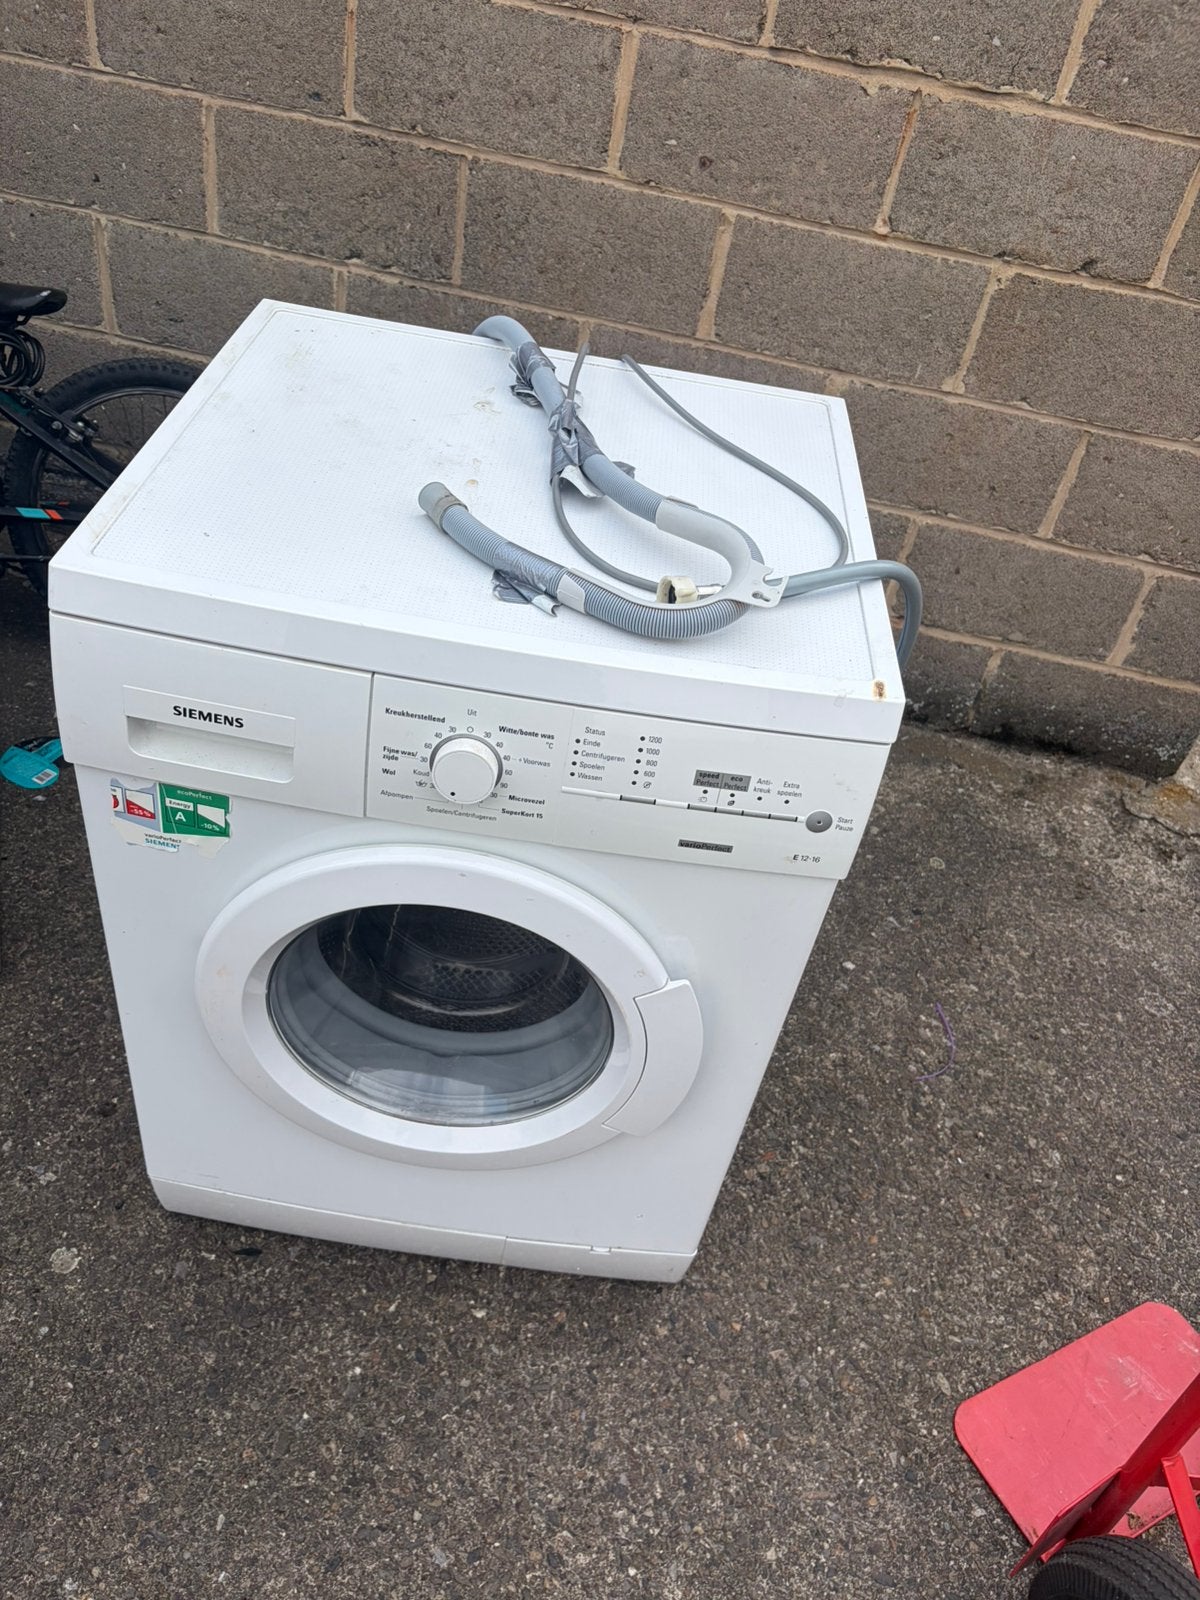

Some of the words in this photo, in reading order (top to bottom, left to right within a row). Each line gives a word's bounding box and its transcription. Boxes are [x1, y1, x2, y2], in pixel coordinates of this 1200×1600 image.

[173, 705, 244, 728] SIEMENS
[385, 707, 446, 723] Kreukherstellend
[467, 708, 478, 717] Uit
[499, 725, 539, 738] Witte/bonte
[585, 727, 605, 736] Status
[583, 739, 601, 747] Einde
[648, 736, 662, 744] 1200
[496, 741, 504, 749] 40
[383, 746, 400, 755] Fijne
[646, 748, 660, 756] 1000
[581, 750, 625, 762] Centrifugeren
[523, 757, 551, 768] Voorwas
[579, 761, 605, 771] Spoelen
[646, 759, 658, 767] 800
[382, 768, 396, 776] Wol
[413, 769, 430, 777] Koud
[577, 772, 603, 781] Wassen
[699, 772, 720, 780] speed
[696, 779, 719, 788] Perfect
[756, 778, 773, 786] Anti-
[783, 781, 800, 790] Extra
[724, 782, 748, 792] Perfect
[753, 787, 771, 795] kreuk
[177, 789, 212, 801] ecoPerfect
[777, 790, 802, 799] spoelen
[508, 794, 545, 805] Microvezel
[168, 799, 192, 810] Energy
[175, 811, 186, 822] A
[426, 806, 497, 822] Spoelen/Centrifugeren
[501, 808, 535, 819] SuperKort
[837, 816, 853, 825] Start
[835, 825, 854, 833] Pauze
[679, 841, 731, 853] varioPerfect
